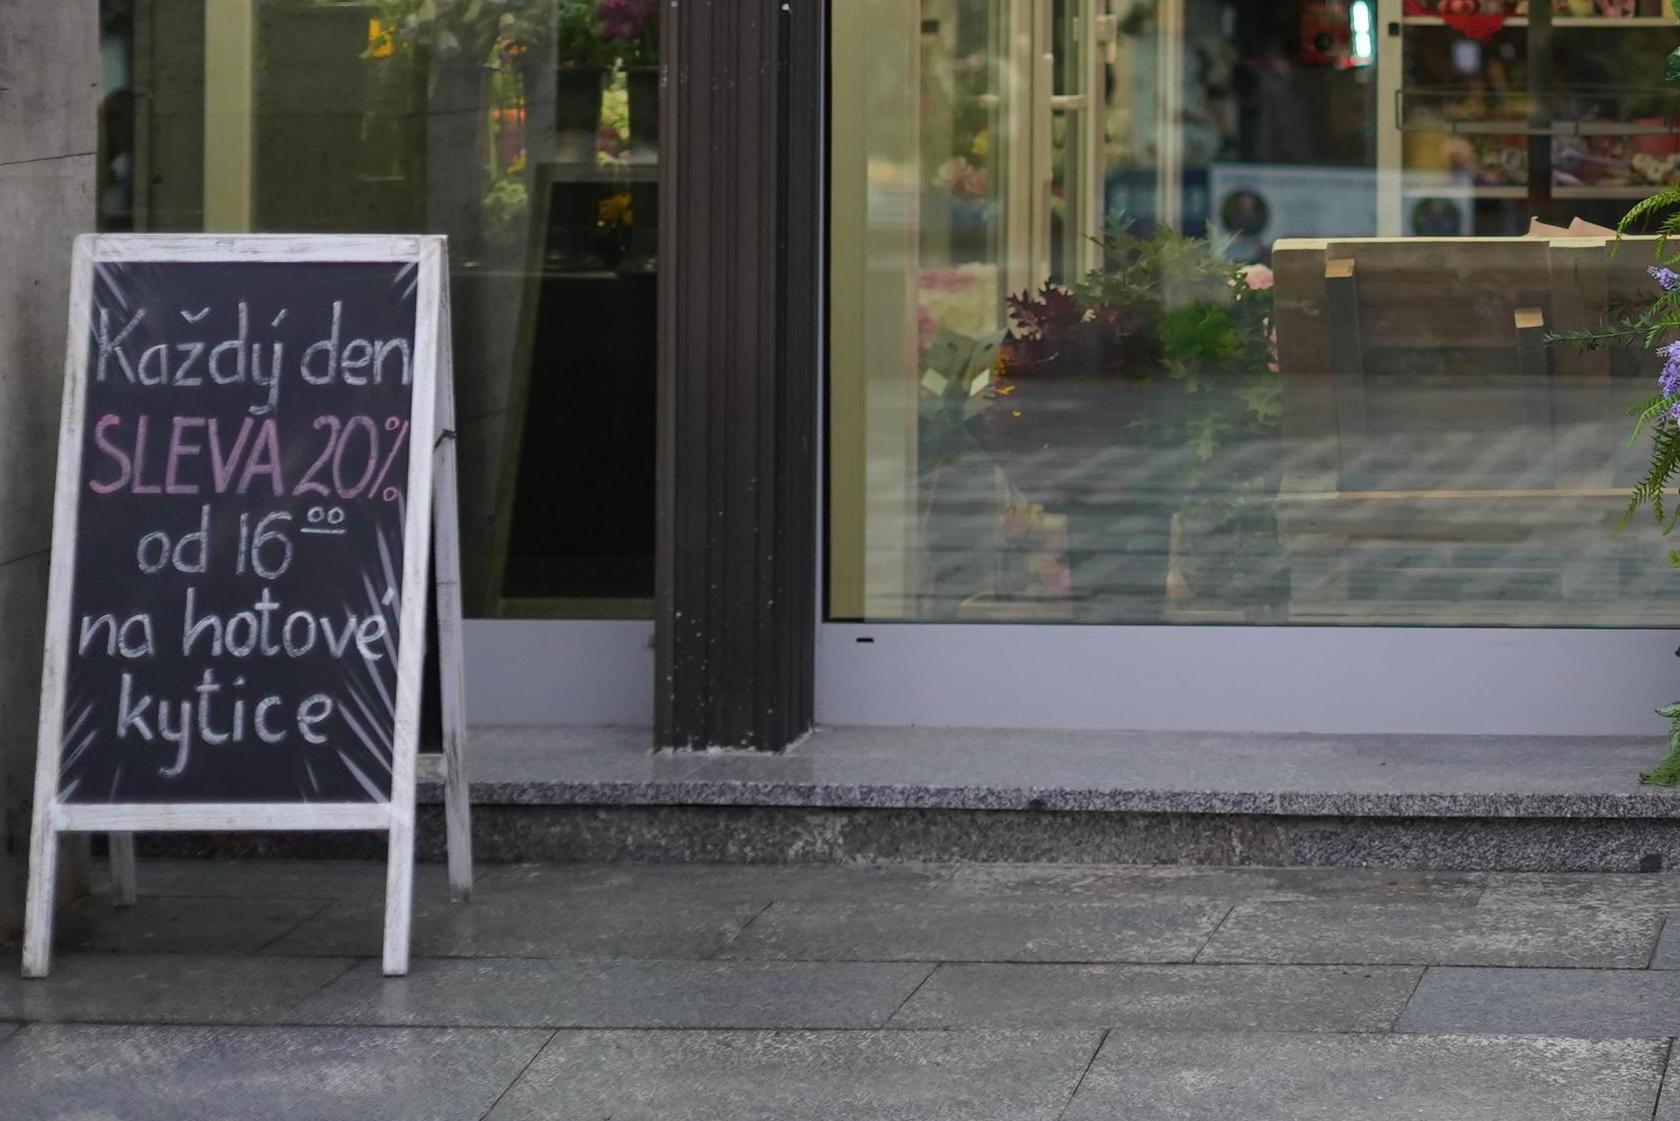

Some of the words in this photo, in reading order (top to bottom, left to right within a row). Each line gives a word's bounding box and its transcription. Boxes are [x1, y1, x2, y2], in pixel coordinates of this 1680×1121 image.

[96, 300, 288, 415] Každý
[300, 300, 413, 386] den
[89, 414, 285, 497] SLEVA
[292, 414, 410, 502] 20%
[136, 504, 211, 574] od
[78, 612, 155, 658] na
[182, 586, 394, 660] hotové
[116, 669, 333, 777] kytice
